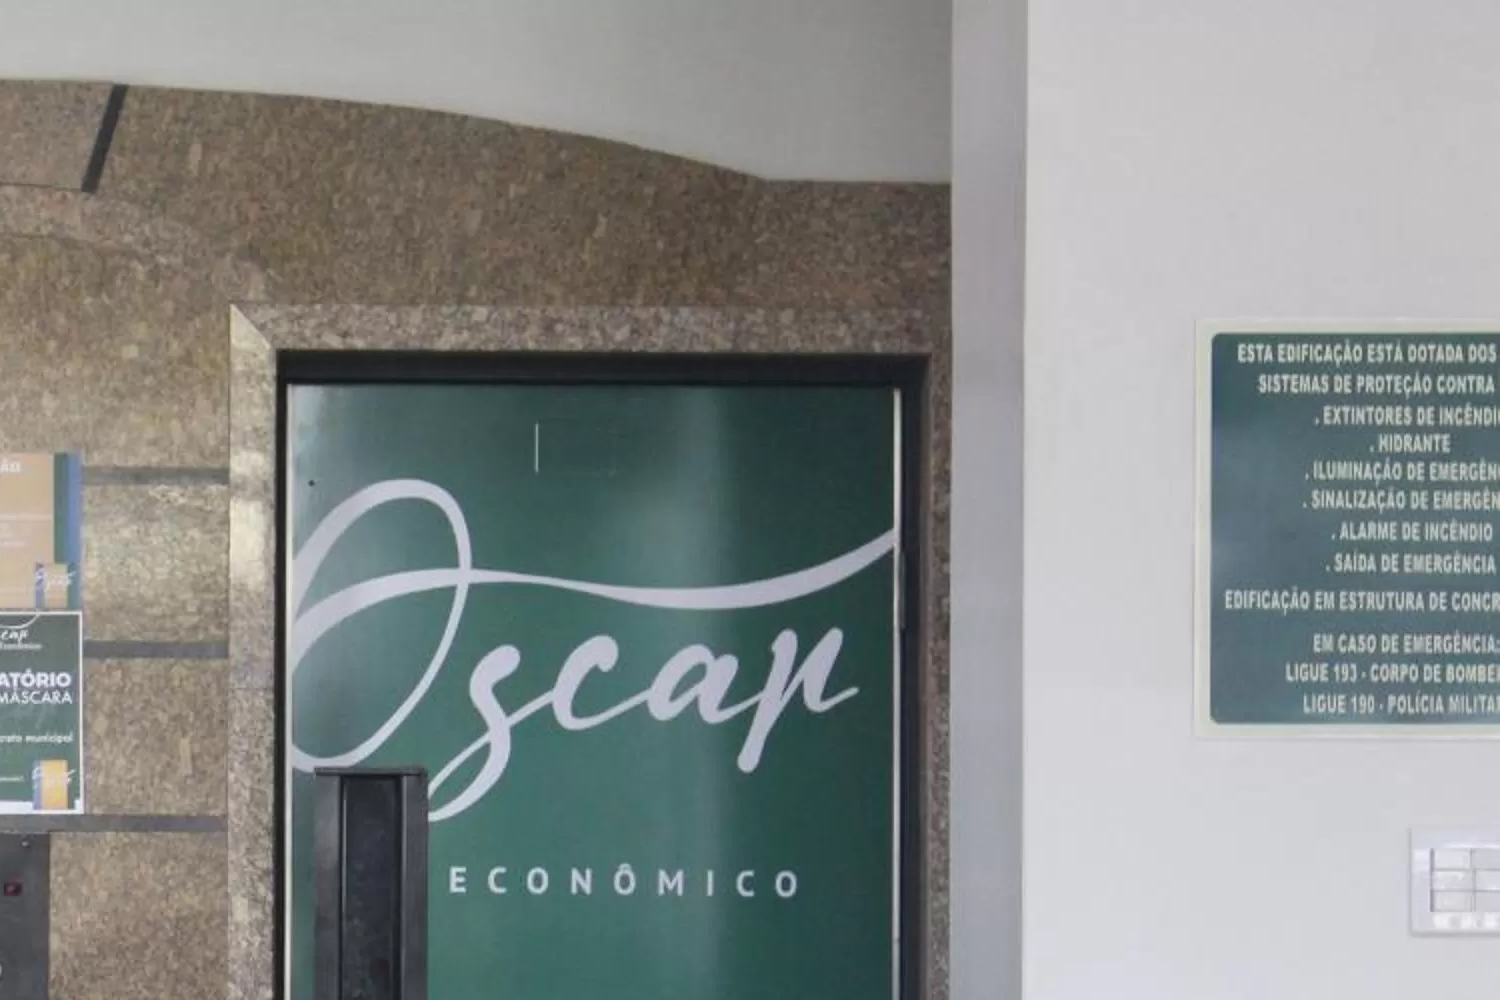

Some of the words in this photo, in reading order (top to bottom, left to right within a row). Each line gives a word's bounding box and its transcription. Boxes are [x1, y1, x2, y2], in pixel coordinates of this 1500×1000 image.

[1238, 343, 1272, 363] ESTA
[1278, 339, 1363, 366] EDIFICAÇÃO
[1367, 340, 1402, 363] ESTÁ
[1408, 343, 1463, 363] DOTADA
[1468, 344, 1497, 363] DOS
[1258, 374, 1329, 394] SISTEMAS
[1333, 374, 1351, 393] DE
[1356, 370, 1432, 399] PROTEÇÃO
[1437, 374, 1495, 394] CONTRA
[1323, 405, 1412, 426] EXTINTORES
[1417, 405, 1435, 426] DE
[1440, 402, 1500, 427] INCÊNDI
[1378, 433, 1451, 453] HIDRANTE
[1313, 457, 1402, 487] ILUMINAÇÃO
[1407, 461, 1425, 481] DE
[1430, 457, 1500, 481] EMERGÊN
[1311, 486, 1405, 514] SINALIZAÇÃO
[1410, 490, 1428, 509] DE
[1339, 521, 1397, 541] ALARME
[1402, 521, 1420, 541] DE
[1425, 517, 1493, 541] INCÊNDIO
[1333, 550, 1376, 573] SAÍDA
[1381, 553, 1399, 573] DE
[1403, 551, 1496, 573] EMERGÊNCIA
[1225, 586, 1310, 616] EDIFICAÇÃO
[1315, 590, 1335, 610] EM
[1339, 590, 1425, 611] ESTRUTURA
[1428, 591, 1447, 612] DE
[1313, 633, 1333, 652] EM
[1337, 633, 1376, 653] CASO
[1381, 633, 1399, 653] DE
[1286, 663, 1329, 682] LIGUE
[1333, 663, 1357, 682] 193
[1370, 664, 1418, 683] CORPO
[1423, 664, 1441, 683] DE
[1303, 694, 1346, 714] LIGUE
[1351, 694, 1375, 714] 190
[1388, 690, 1444, 714] POLÍCIA
[451, 864, 799, 898] ECONÔMICO
